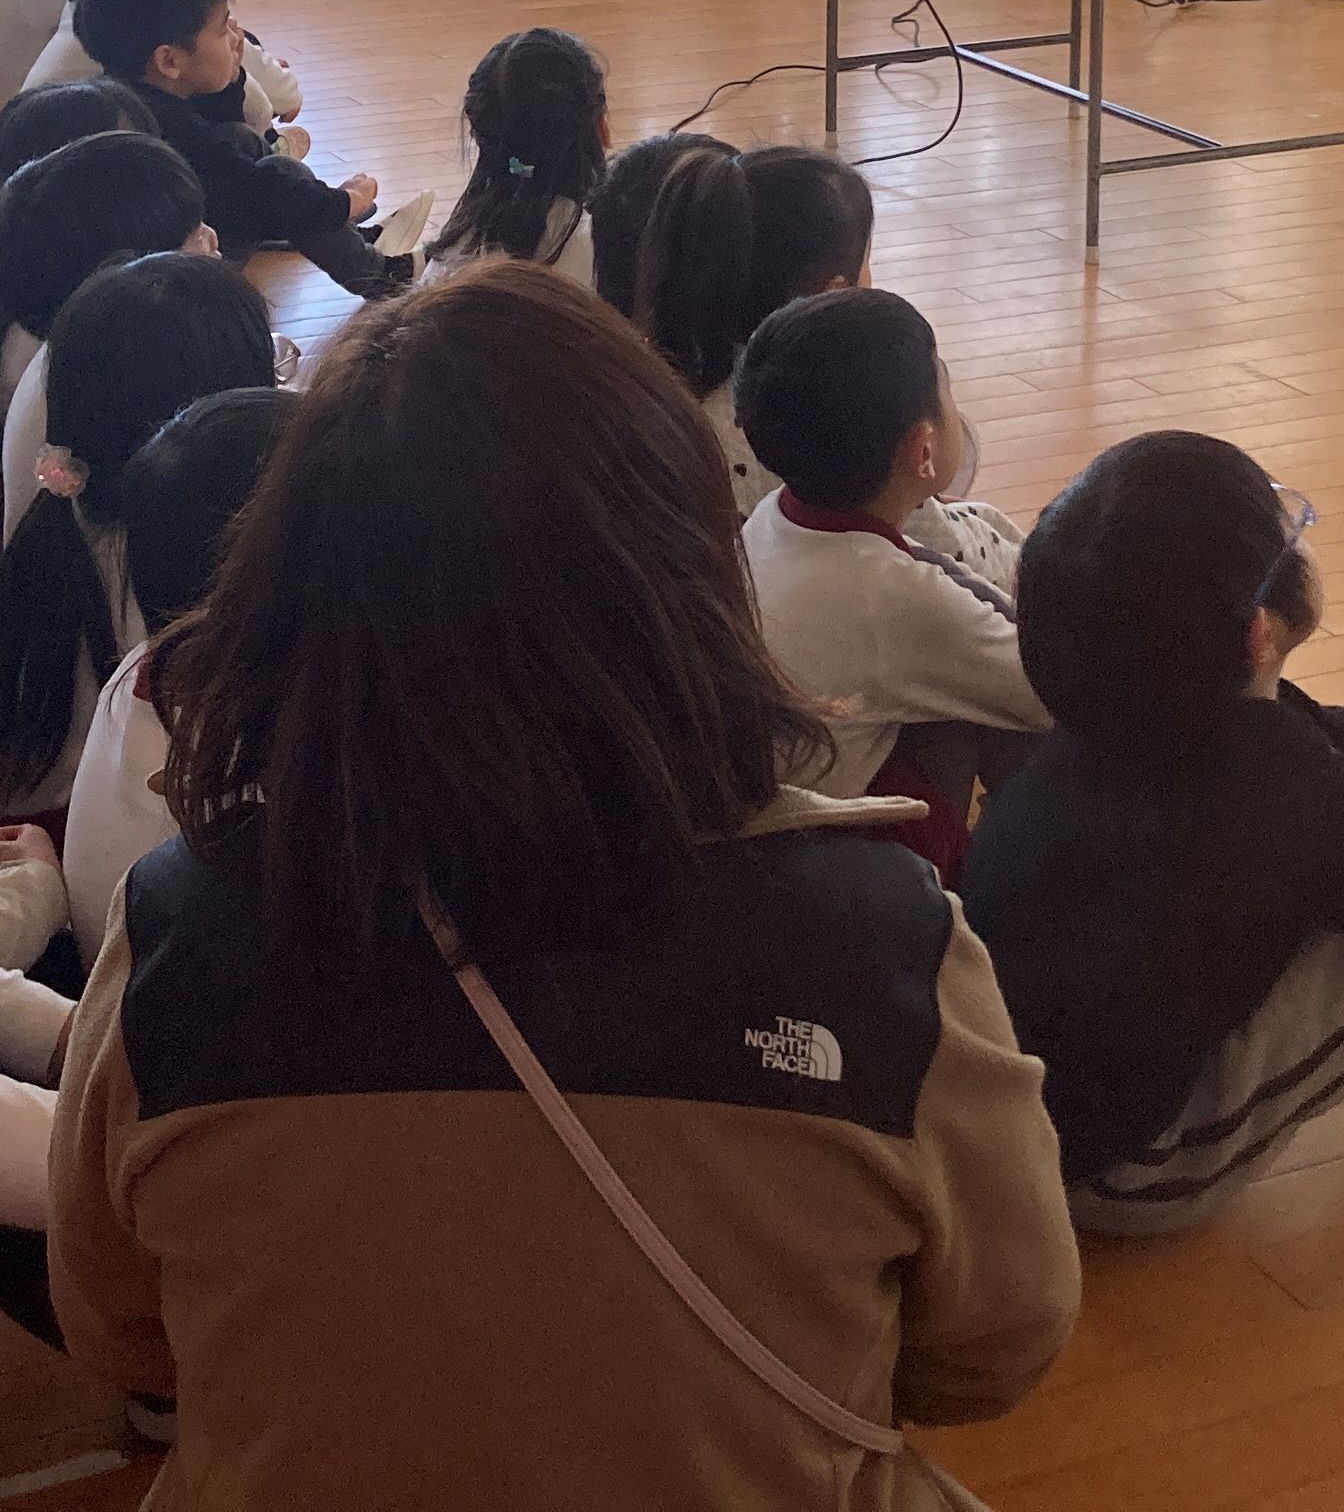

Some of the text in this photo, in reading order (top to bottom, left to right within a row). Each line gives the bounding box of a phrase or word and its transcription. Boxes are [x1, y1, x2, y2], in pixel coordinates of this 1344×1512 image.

[775, 1015, 813, 1040] THE
[744, 1027, 811, 1058] NORTH
[762, 1049, 812, 1076] FACE
